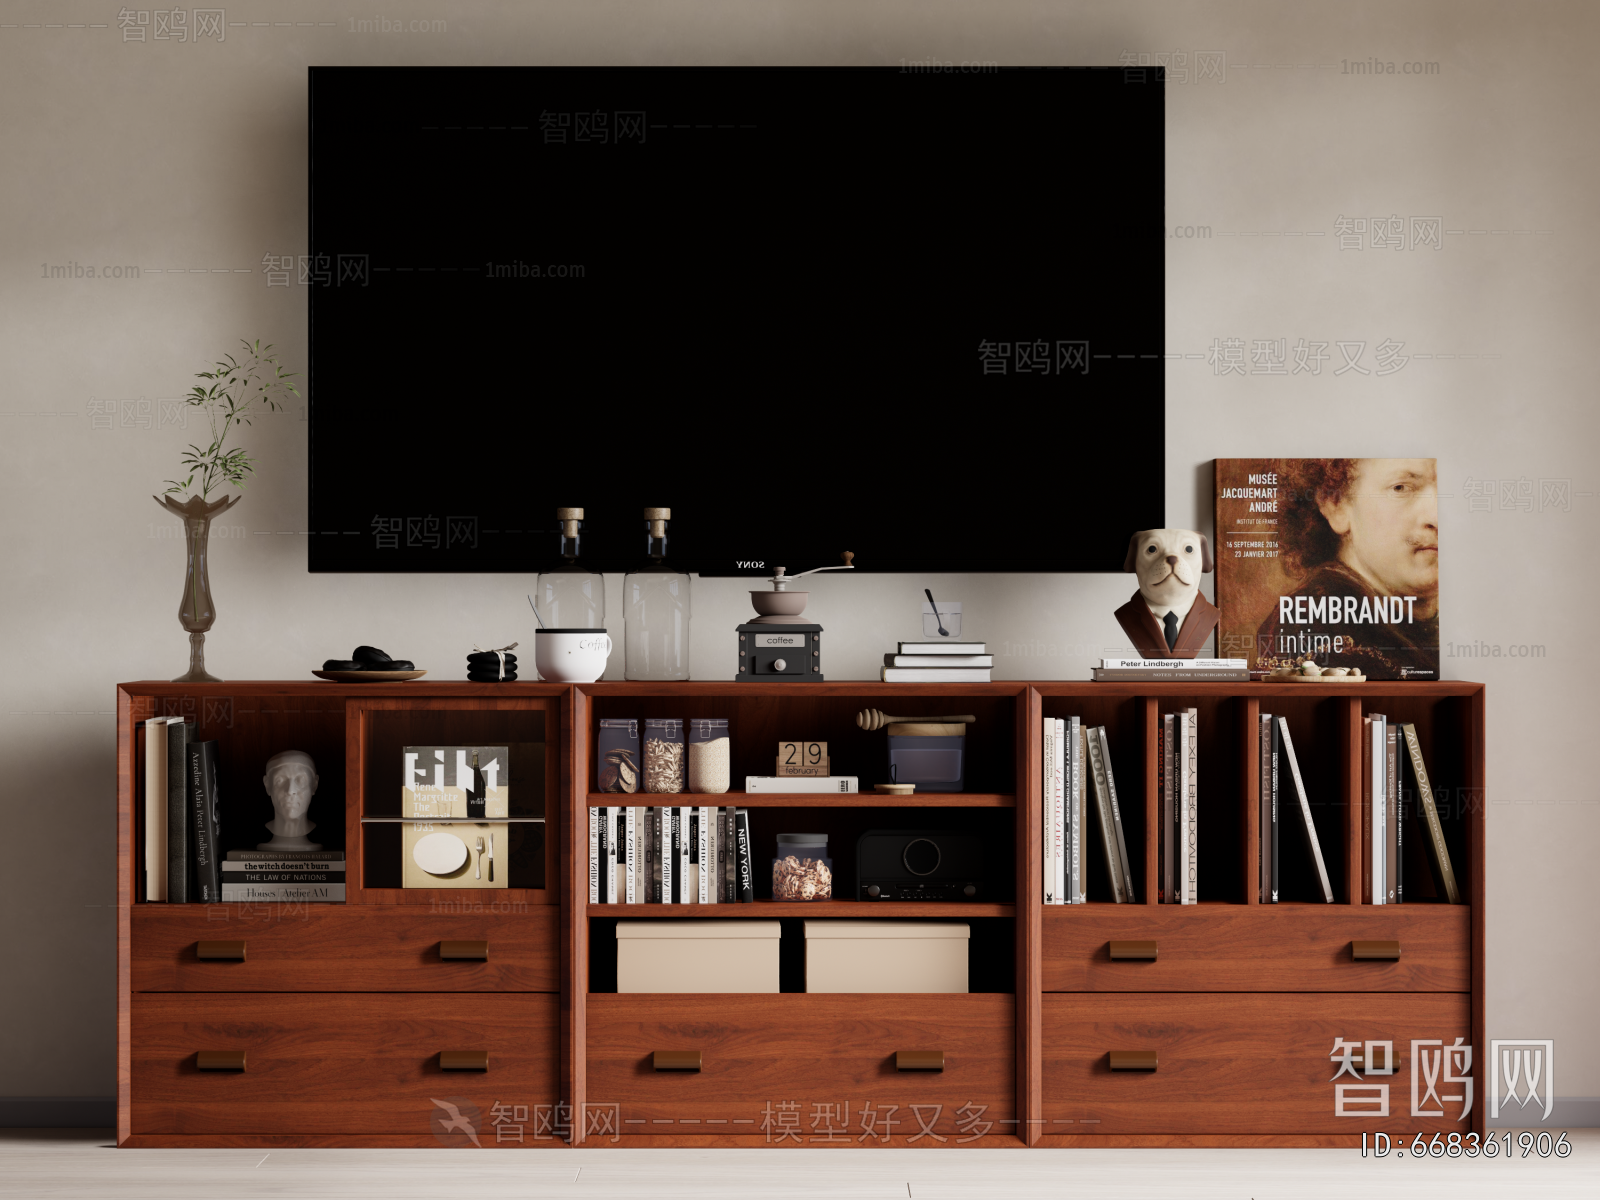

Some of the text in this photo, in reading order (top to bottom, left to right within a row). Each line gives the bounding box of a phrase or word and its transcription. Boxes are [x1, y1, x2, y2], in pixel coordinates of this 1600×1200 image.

[1248, 471, 1278, 485] MUSÉE
[1221, 487, 1278, 499] JACQUEMART
[1249, 500, 1278, 513] ANDRÉ
[1279, 596, 1417, 625] REMBRANDT
[766, 636, 794, 645] coffee
[1280, 628, 1344, 654] intime
[1143, 660, 1184, 669] Lindbergh
[785, 766, 819, 777] february
[192, 752, 200, 786] Azzedine
[198, 830, 209, 866] Lindbergh
[413, 803, 430, 812] The
[737, 828, 750, 891] NEW YORK
[244, 862, 330, 870] the witch doesn't burn
[247, 887, 328, 898] Houses Atelier AM
